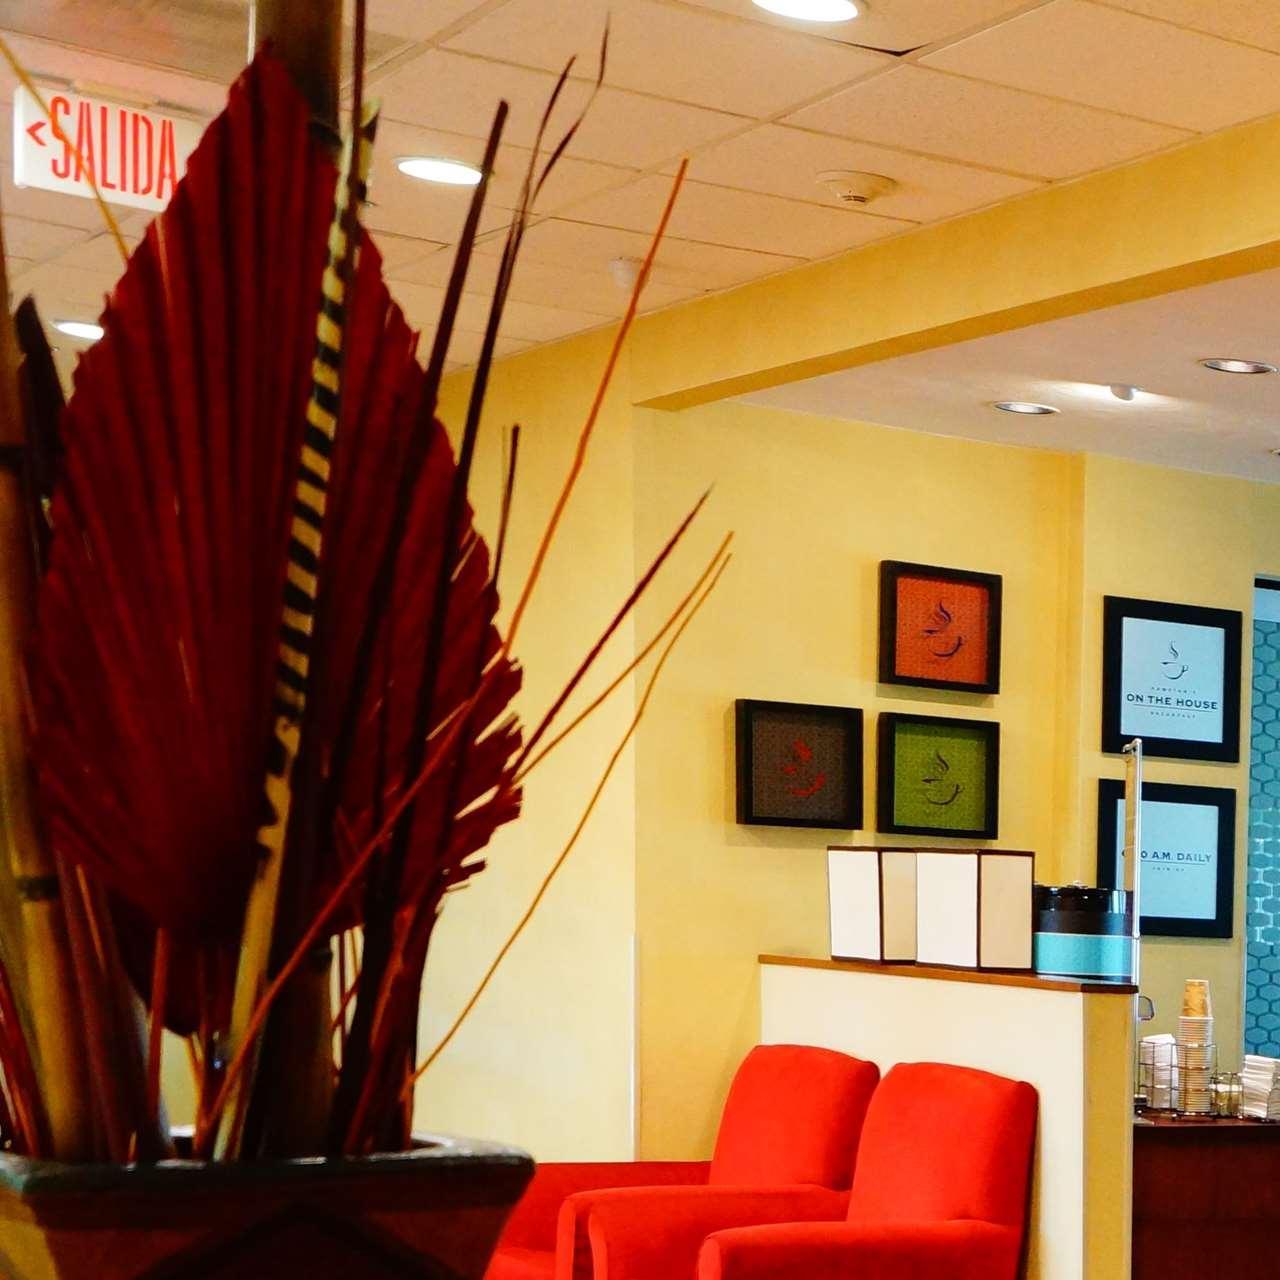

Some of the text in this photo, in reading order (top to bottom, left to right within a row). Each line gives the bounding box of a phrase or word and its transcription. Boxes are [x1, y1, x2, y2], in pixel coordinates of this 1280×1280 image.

[50, 96, 179, 200] SALIDA
[1126, 693, 1218, 710] ON THE HOUSE
[1176, 853, 1212, 863] DAILY
